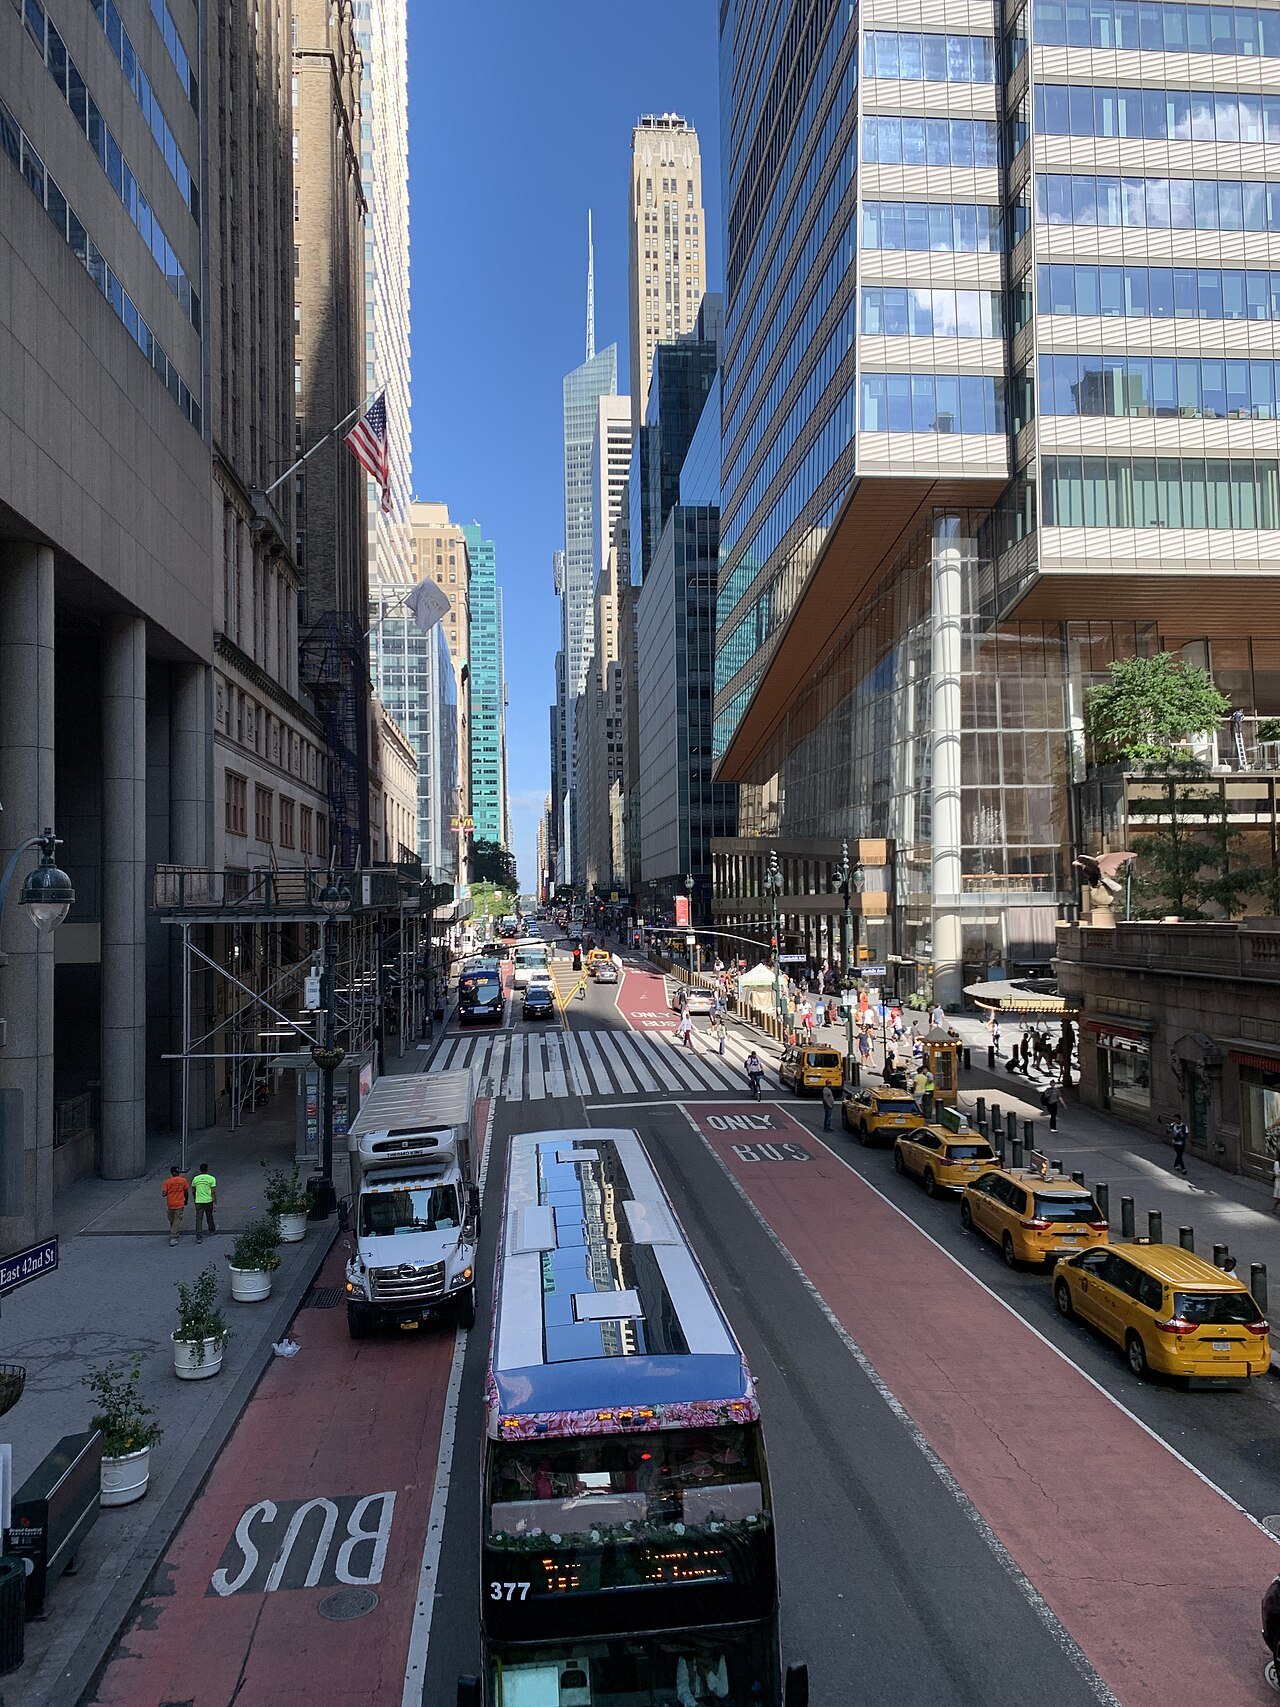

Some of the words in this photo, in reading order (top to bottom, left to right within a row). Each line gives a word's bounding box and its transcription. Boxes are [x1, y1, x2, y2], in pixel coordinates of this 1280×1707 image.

[631, 1011, 672, 1019] ONLY
[706, 1114, 776, 1131] ONLY
[386, 1150, 410, 1158] THERMO
[731, 1143, 810, 1162] BUS
[0, 1265, 20, 1285] East
[22, 1252, 43, 1275] 42nd
[45, 1248, 54, 1264] St
[211, 1490, 397, 1597] BUS
[490, 1582, 531, 1601] 377
